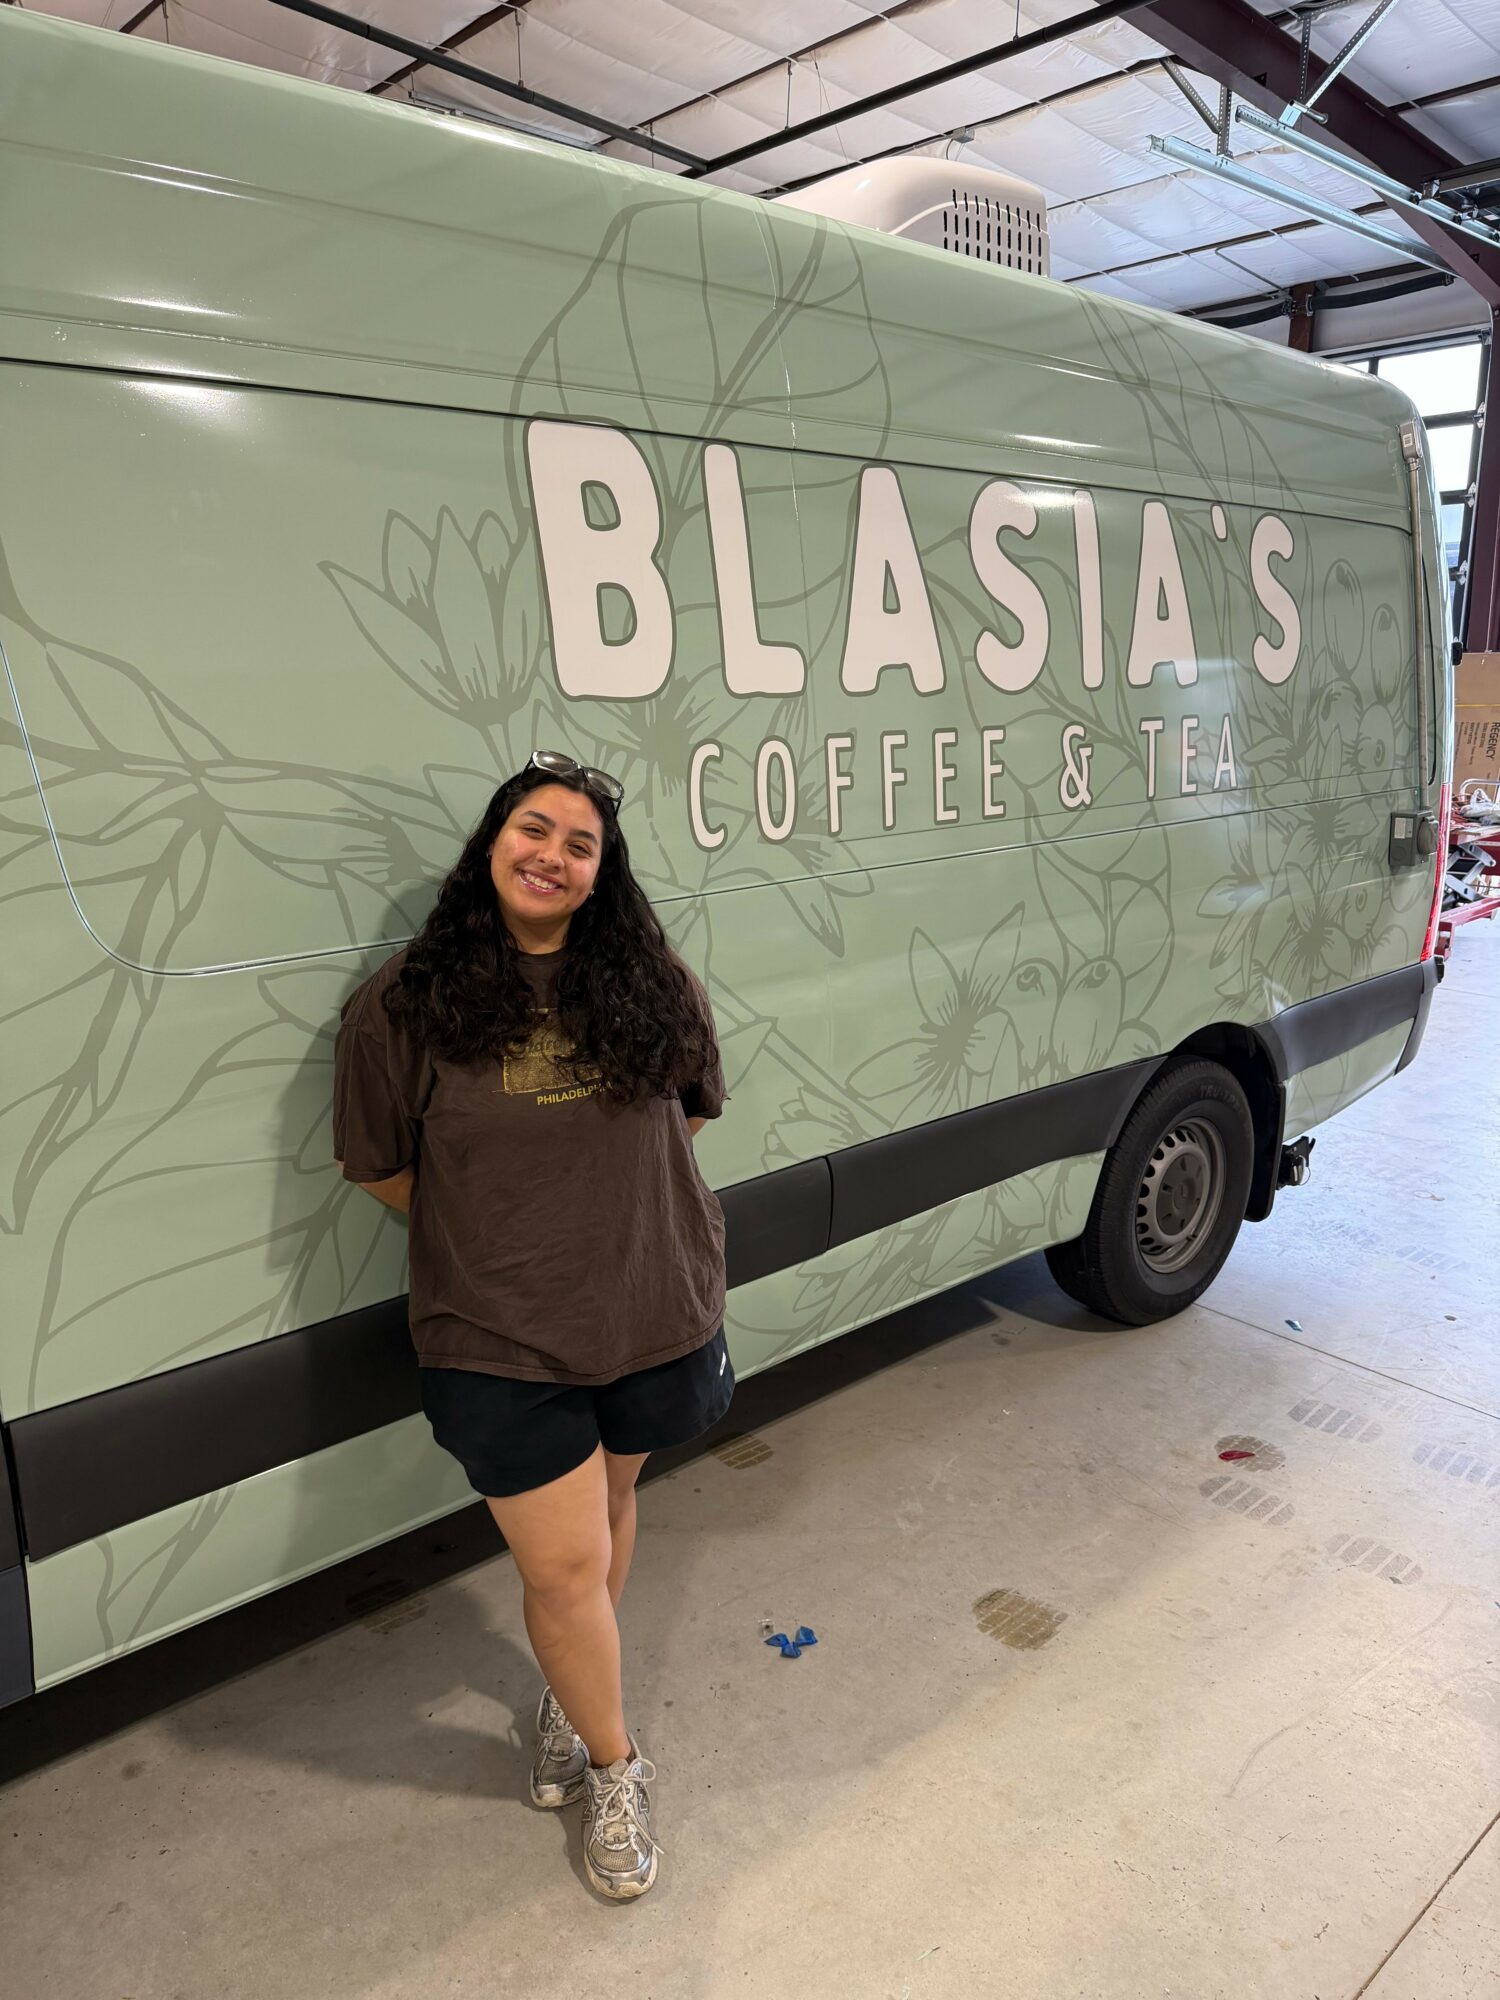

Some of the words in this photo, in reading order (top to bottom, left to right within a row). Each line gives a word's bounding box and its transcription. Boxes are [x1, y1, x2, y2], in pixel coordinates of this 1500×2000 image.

[527, 419, 1301, 698] BLASIA'S
[690, 731, 1006, 848] COFFEE
[1060, 726, 1092, 808] &
[1139, 714, 1238, 798] TEA
